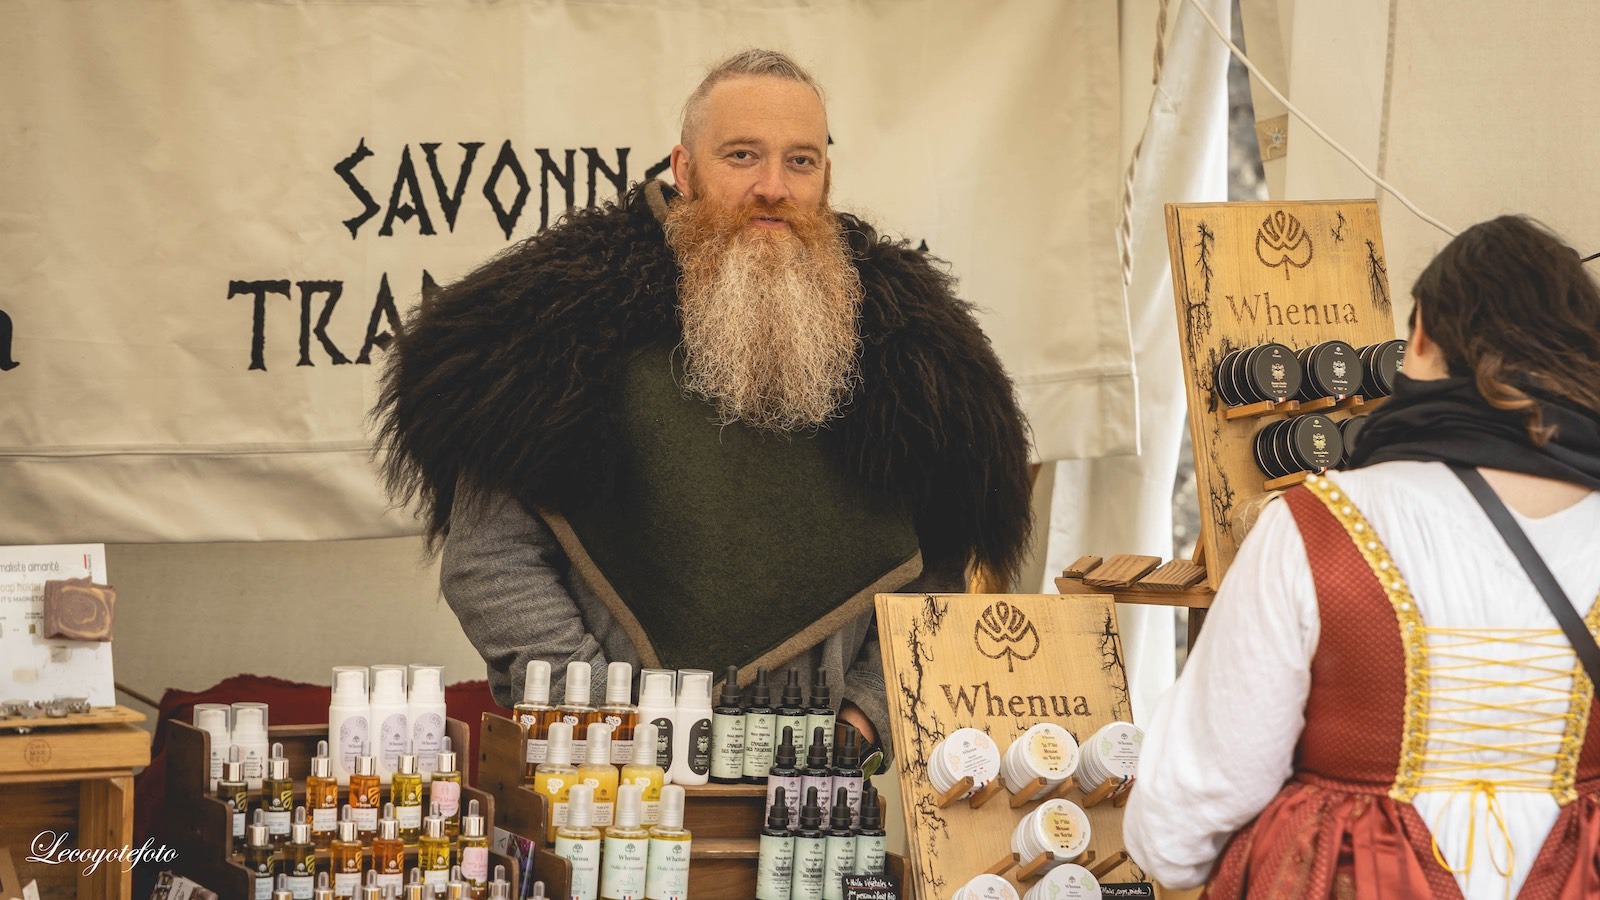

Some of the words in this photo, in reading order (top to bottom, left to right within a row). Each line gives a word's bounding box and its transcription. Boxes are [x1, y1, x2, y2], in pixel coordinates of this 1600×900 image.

[227, 269, 446, 370] TRA
[1225, 292, 1358, 327] Whenua
[28, 560, 59, 572] aimanté
[17, 581, 41, 592] holder
[939, 681, 1092, 718] Whenua
